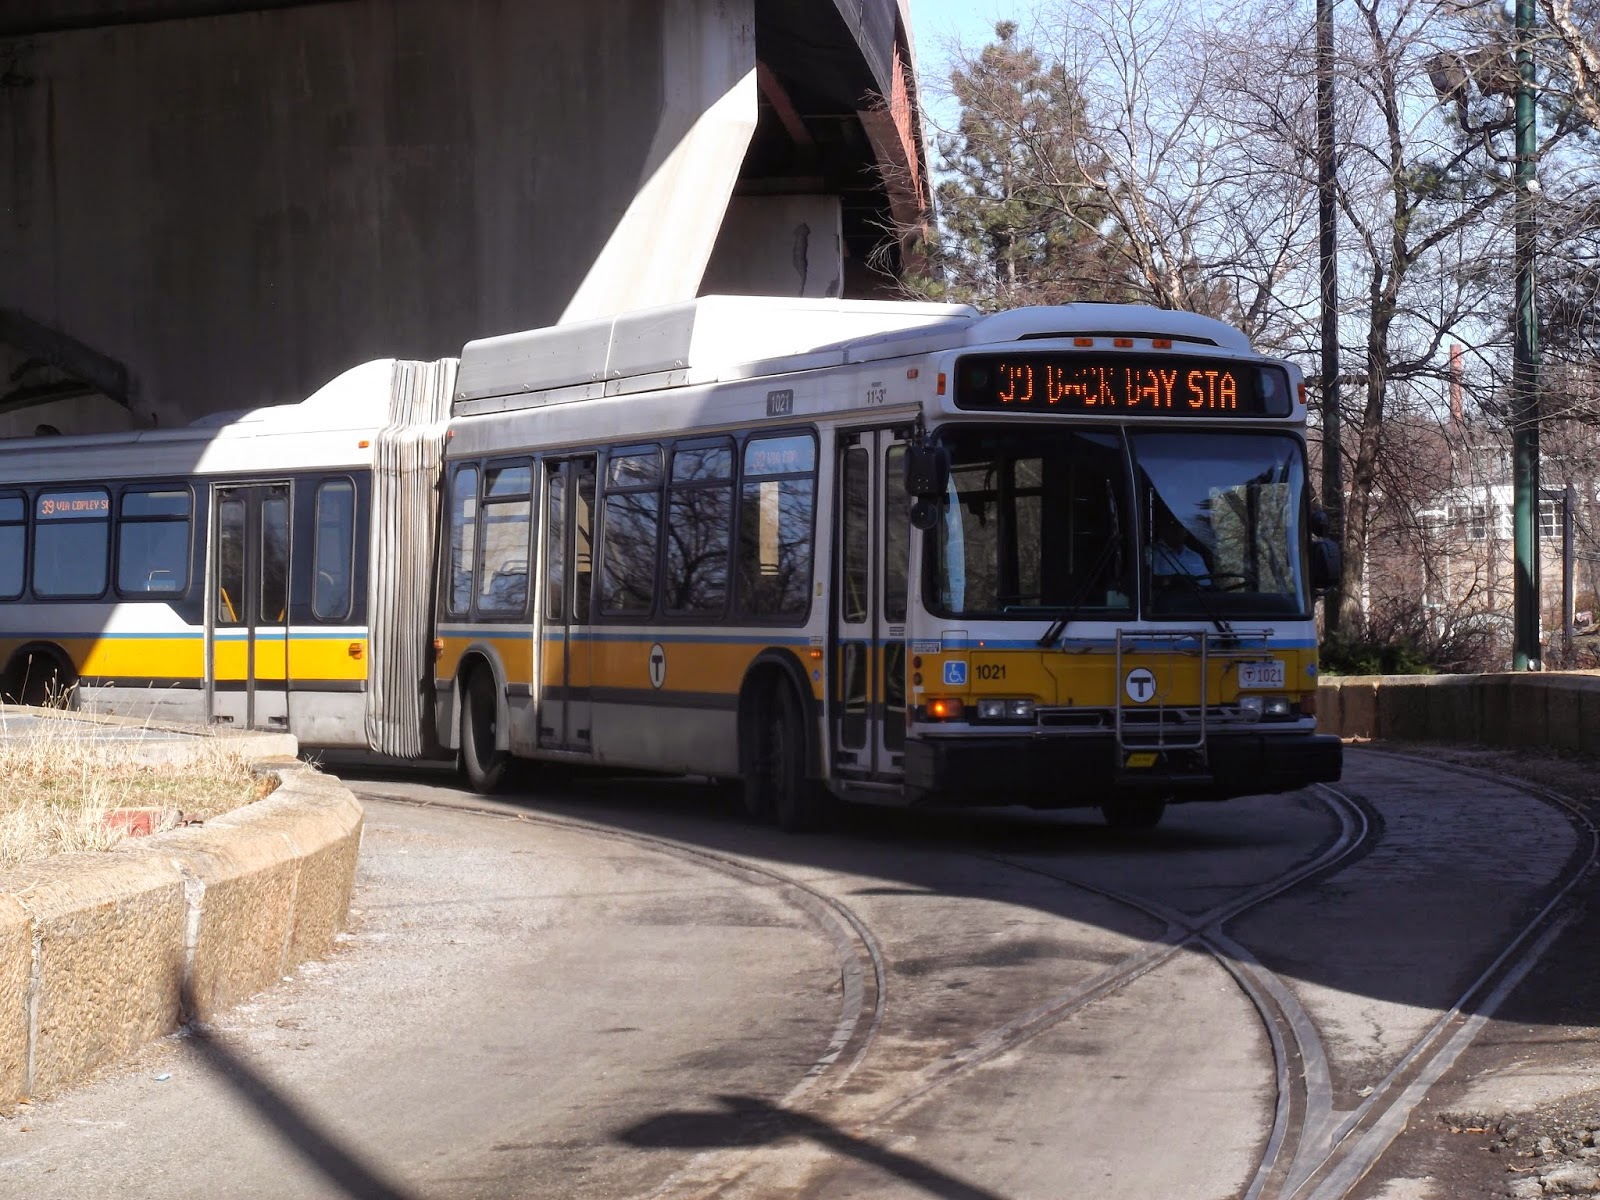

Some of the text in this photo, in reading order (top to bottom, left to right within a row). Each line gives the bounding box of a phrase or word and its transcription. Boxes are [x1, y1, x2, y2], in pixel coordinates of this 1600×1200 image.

[1125, 367, 1178, 407] BAY
[1187, 370, 1238, 410] STA
[771, 392, 790, 413] 1021
[41, 499, 55, 515] 39
[56, 501, 70, 511] VIA
[71, 500, 99, 511] COPLEY
[975, 664, 1007, 680] 1021
[1257, 668, 1283, 683] 1021
[1130, 676, 1152, 698] T
